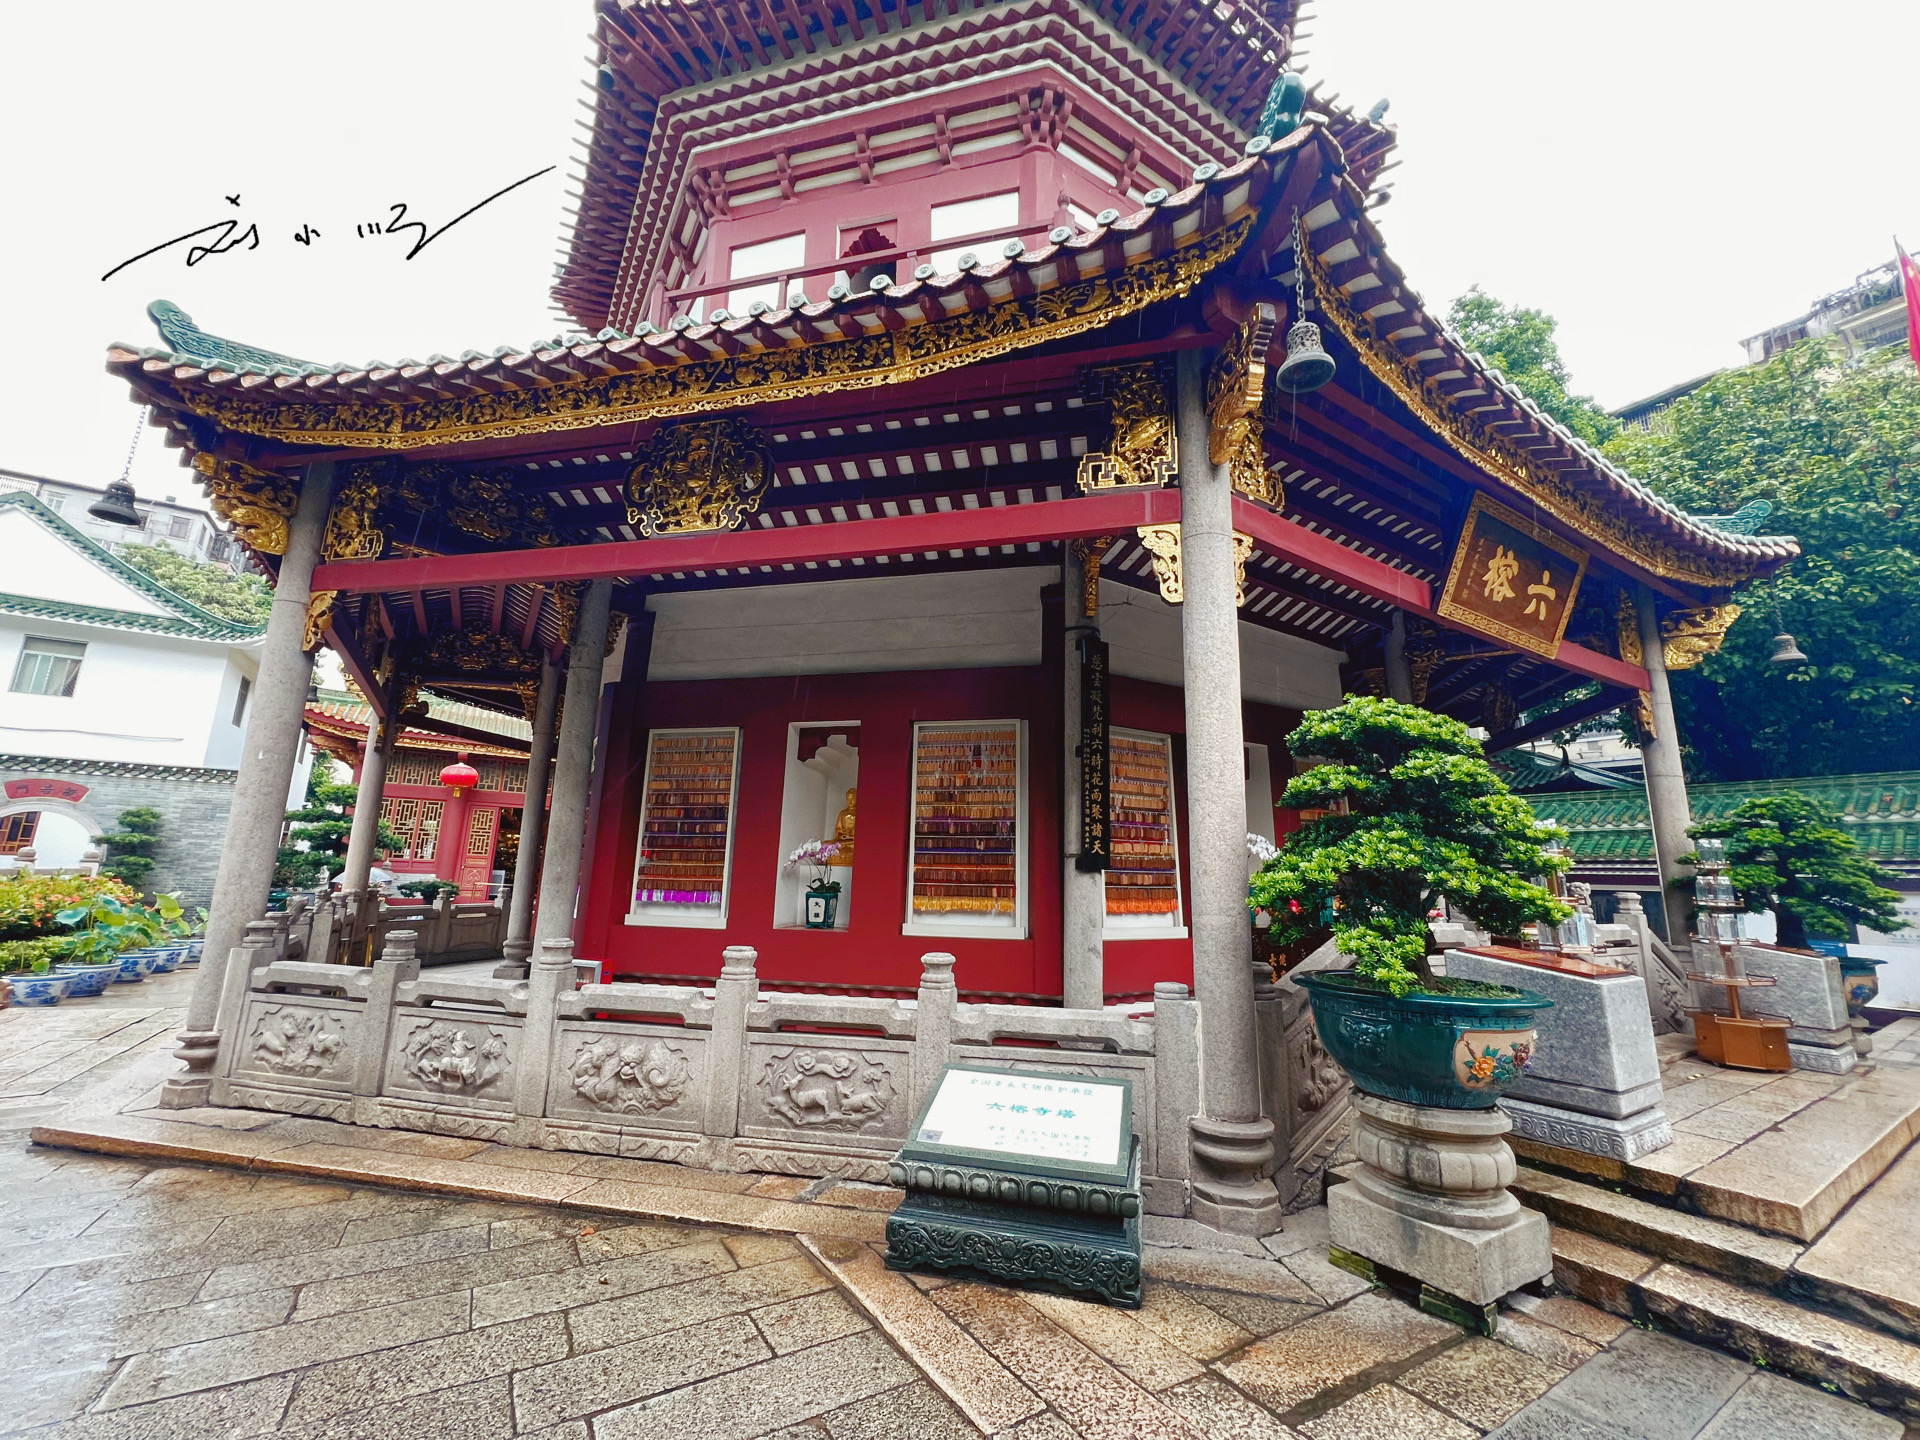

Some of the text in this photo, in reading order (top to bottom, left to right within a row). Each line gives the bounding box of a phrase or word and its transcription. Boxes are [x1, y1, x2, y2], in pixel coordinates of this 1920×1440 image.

[1482, 545, 1556, 621] 六榕
[985, 1101, 1077, 1119] 六榕寺塔
